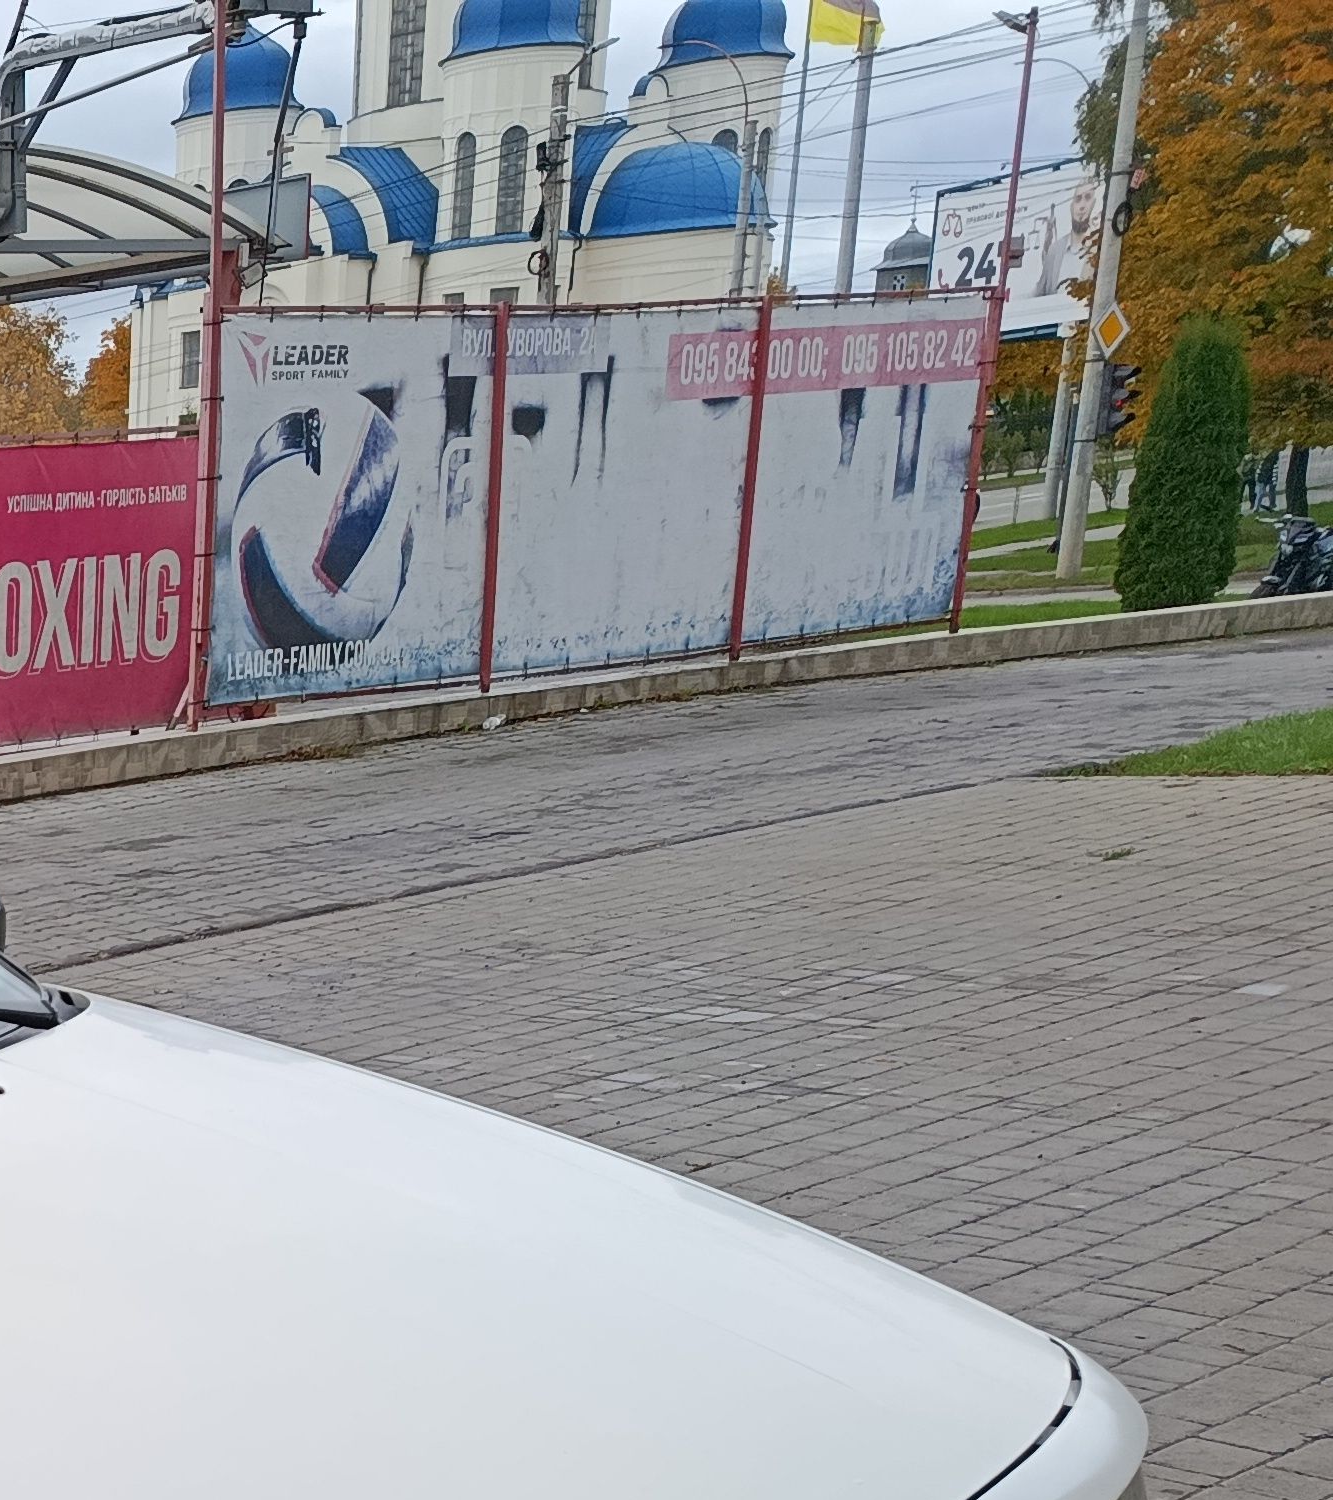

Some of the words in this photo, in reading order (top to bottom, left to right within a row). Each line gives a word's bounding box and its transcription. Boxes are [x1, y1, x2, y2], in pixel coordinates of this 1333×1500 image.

[955, 242, 996, 287] 24
[273, 345, 349, 365] LEADER
[506, 327, 575, 357] УВОРОВА,
[681, 341, 719, 384] 095
[767, 338, 793, 379] 00
[798, 336, 829, 381] 00;
[841, 333, 879, 375] 095
[886, 331, 919, 372] 105
[922, 330, 948, 369] 82
[950, 328, 978, 367] 42
[272, 370, 305, 381] SPORT
[311, 368, 349, 379] FAMILY
[55, 491, 95, 512] ДИТИНА
[148, 484, 187, 504] БАТЬКІВ
